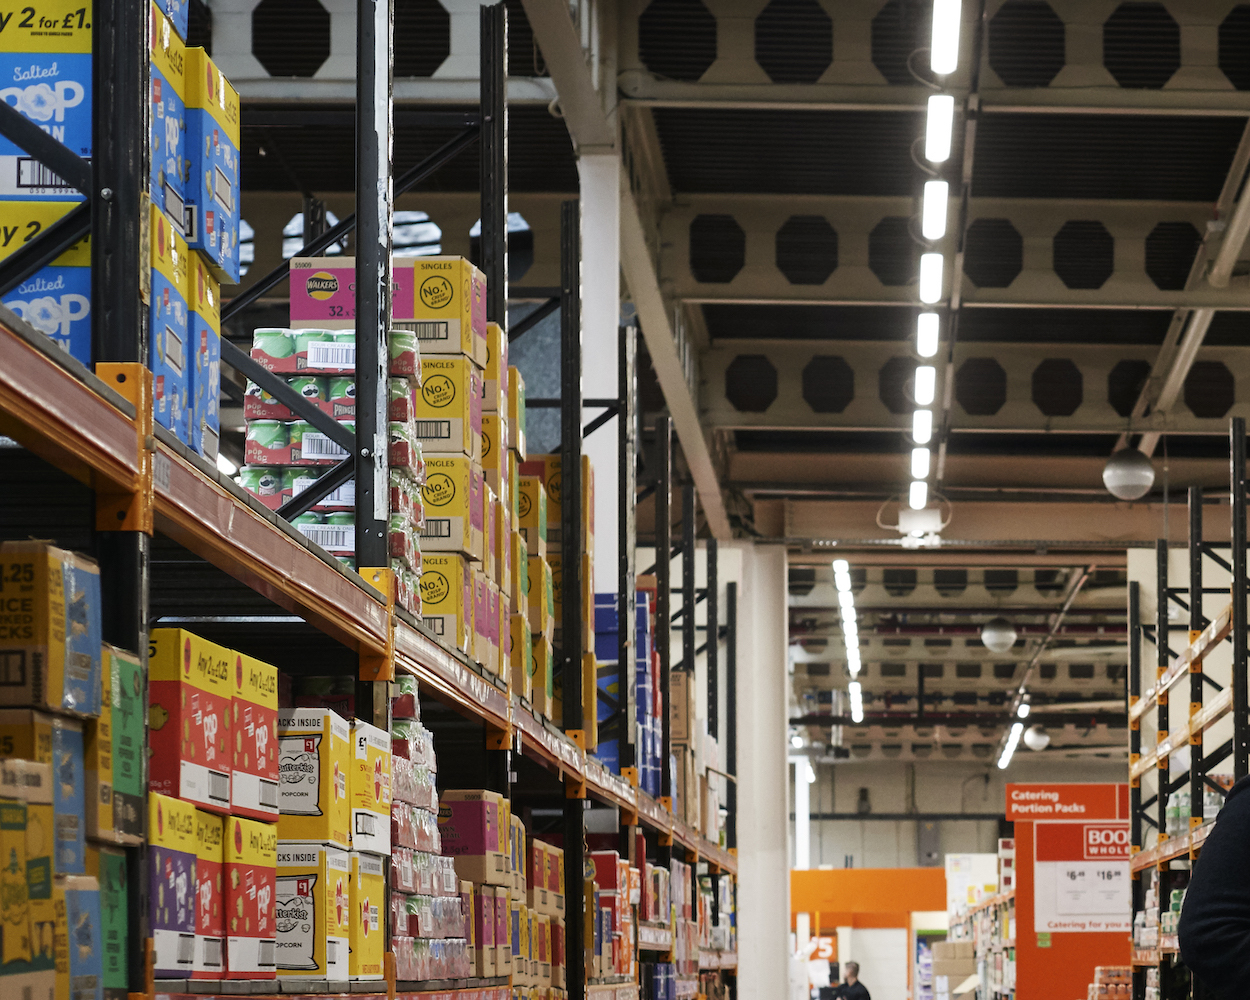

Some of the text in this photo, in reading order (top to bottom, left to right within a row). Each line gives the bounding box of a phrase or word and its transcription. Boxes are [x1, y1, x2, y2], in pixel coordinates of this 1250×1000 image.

[18, 6, 36, 28] 2
[39, 17, 58, 29] for
[62, 8, 91, 29] £1.
[13, 62, 60, 82] Salted
[18, 275, 65, 294] Salted
[307, 279, 338, 290] WALKERS
[423, 281, 448, 298] No.1
[431, 293, 446, 301] CRISP
[329, 306, 343, 317] 32
[425, 380, 450, 397] No.1
[433, 392, 448, 400] CRISP
[334, 404, 355, 417] PRINGL
[425, 478, 450, 495] No.1
[433, 490, 449, 499] CRISP
[424, 558, 448, 566] NGLES
[420, 574, 445, 592] No.1
[279, 718, 321, 727] ACKS INSIDE
[1012, 790, 1059, 802] Catering
[1012, 803, 1085, 813] Portion Packs
[1088, 830, 1129, 844] BOO
[277, 854, 316, 862] CKS INSIDE
[1048, 921, 1086, 929] Catering
